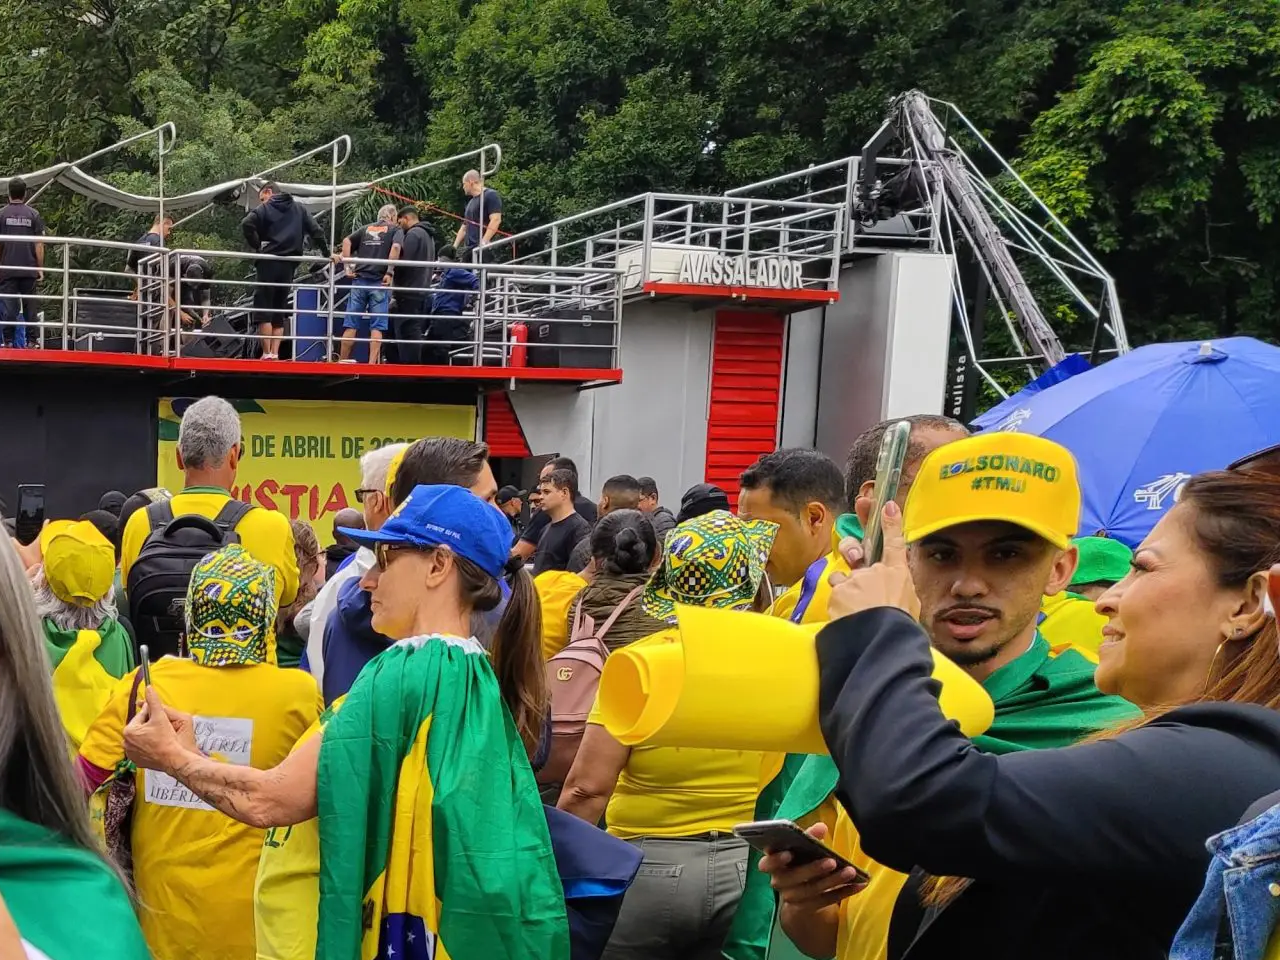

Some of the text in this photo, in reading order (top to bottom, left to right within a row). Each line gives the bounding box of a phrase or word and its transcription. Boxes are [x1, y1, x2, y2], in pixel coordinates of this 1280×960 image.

[678, 252, 803, 289] AVASSALADOR
[251, 435, 276, 458] DE
[281, 435, 336, 459] ABRIL
[341, 436, 365, 459] DE
[939, 454, 1061, 484] BOLSONARO
